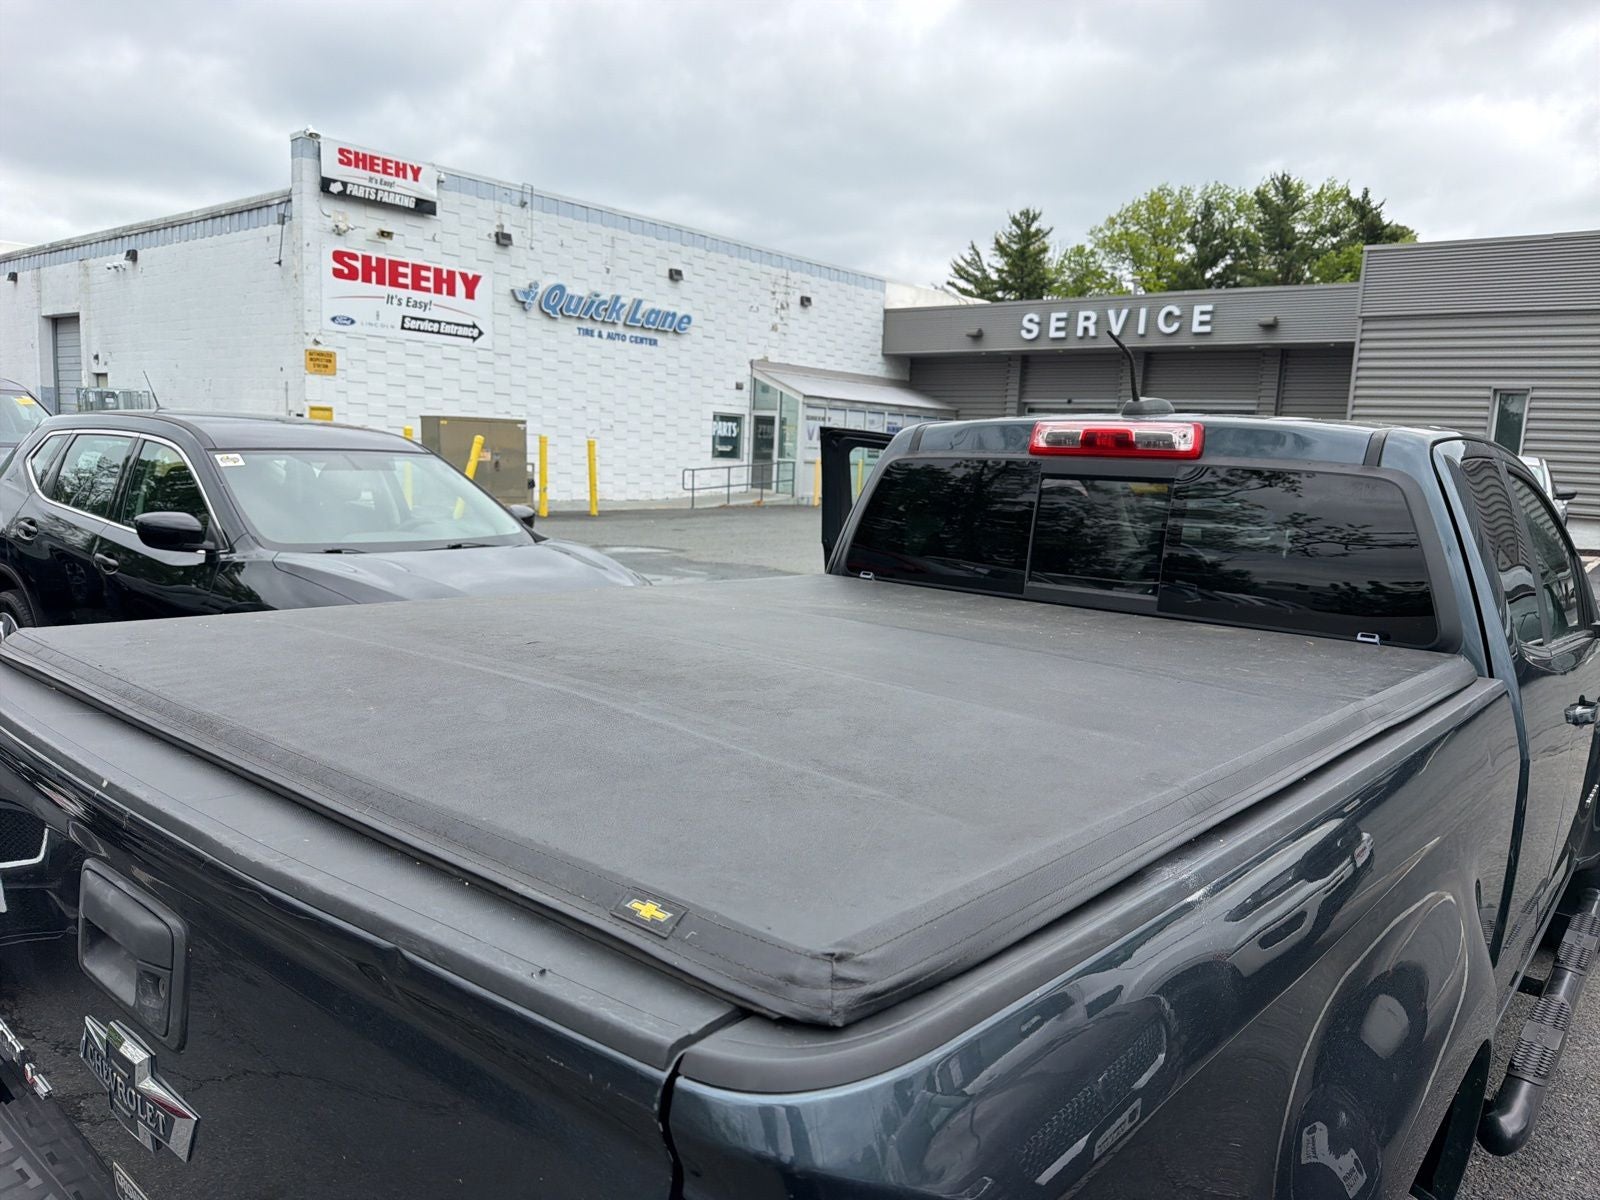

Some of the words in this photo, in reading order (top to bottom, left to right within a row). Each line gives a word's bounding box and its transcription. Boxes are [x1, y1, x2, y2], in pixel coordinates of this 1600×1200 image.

[337, 147, 422, 182] SHEEHY
[368, 176, 379, 184] It's
[380, 178, 396, 189] Easy!
[346, 183, 376, 200] PARTS
[377, 189, 416, 208] PARKING
[332, 250, 482, 300] SHEEHY
[386, 294, 403, 307] It's
[406, 297, 432, 312] Easy!
[541, 283, 627, 321] Quick
[626, 299, 692, 333] Lane
[333, 315, 353, 326] Ford
[403, 318, 439, 333] Service
[440, 322, 480, 338] Entrance
[1020, 304, 1214, 340] SERVICE
[577, 327, 595, 338] TIRE
[597, 330, 603, 339] &
[606, 331, 627, 342] AUTO
[629, 335, 659, 347] CENTER
[712, 421, 737, 437] PARTS
[88, 1046, 166, 1136] CHEVROLET
